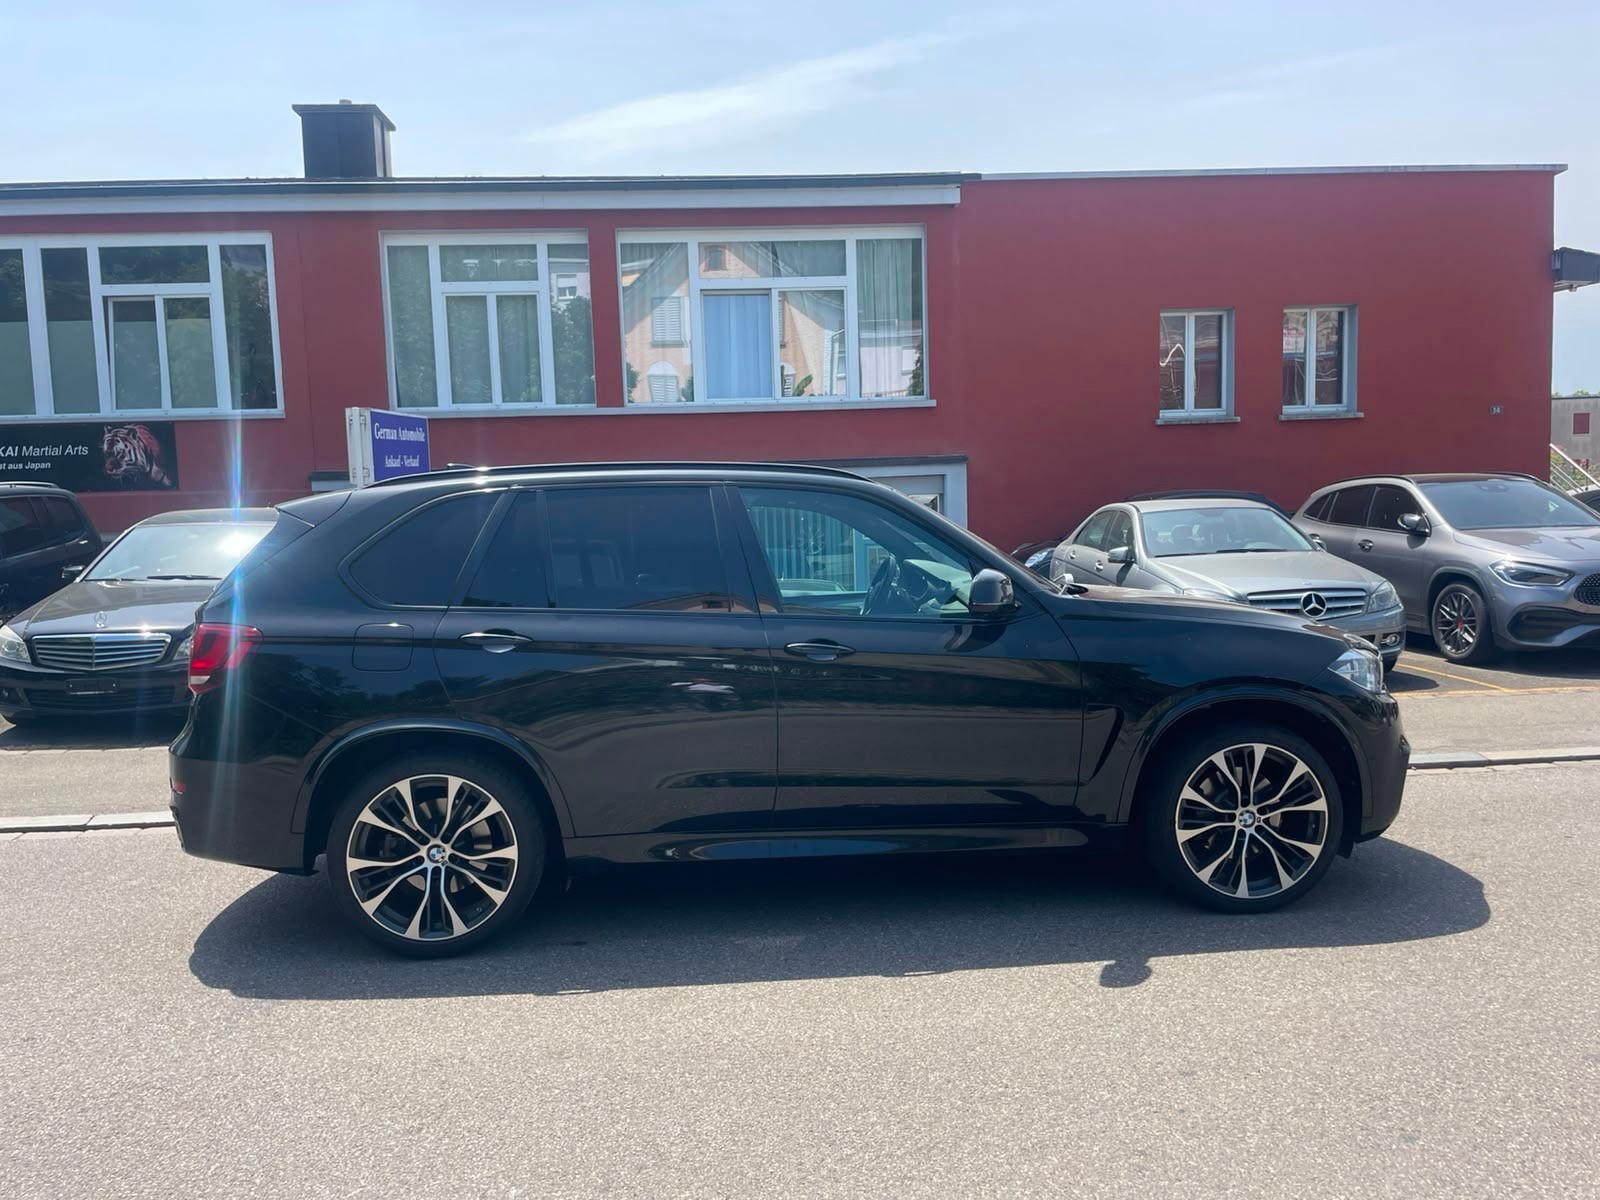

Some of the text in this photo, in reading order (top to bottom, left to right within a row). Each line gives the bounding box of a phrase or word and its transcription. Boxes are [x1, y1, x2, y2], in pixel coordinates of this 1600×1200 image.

[374, 422, 425, 442] German Automobile
[21, 444, 62, 457] Martial
[64, 444, 89, 456] Arts
[7, 462, 23, 470] aus
[24, 461, 51, 471] Japan
